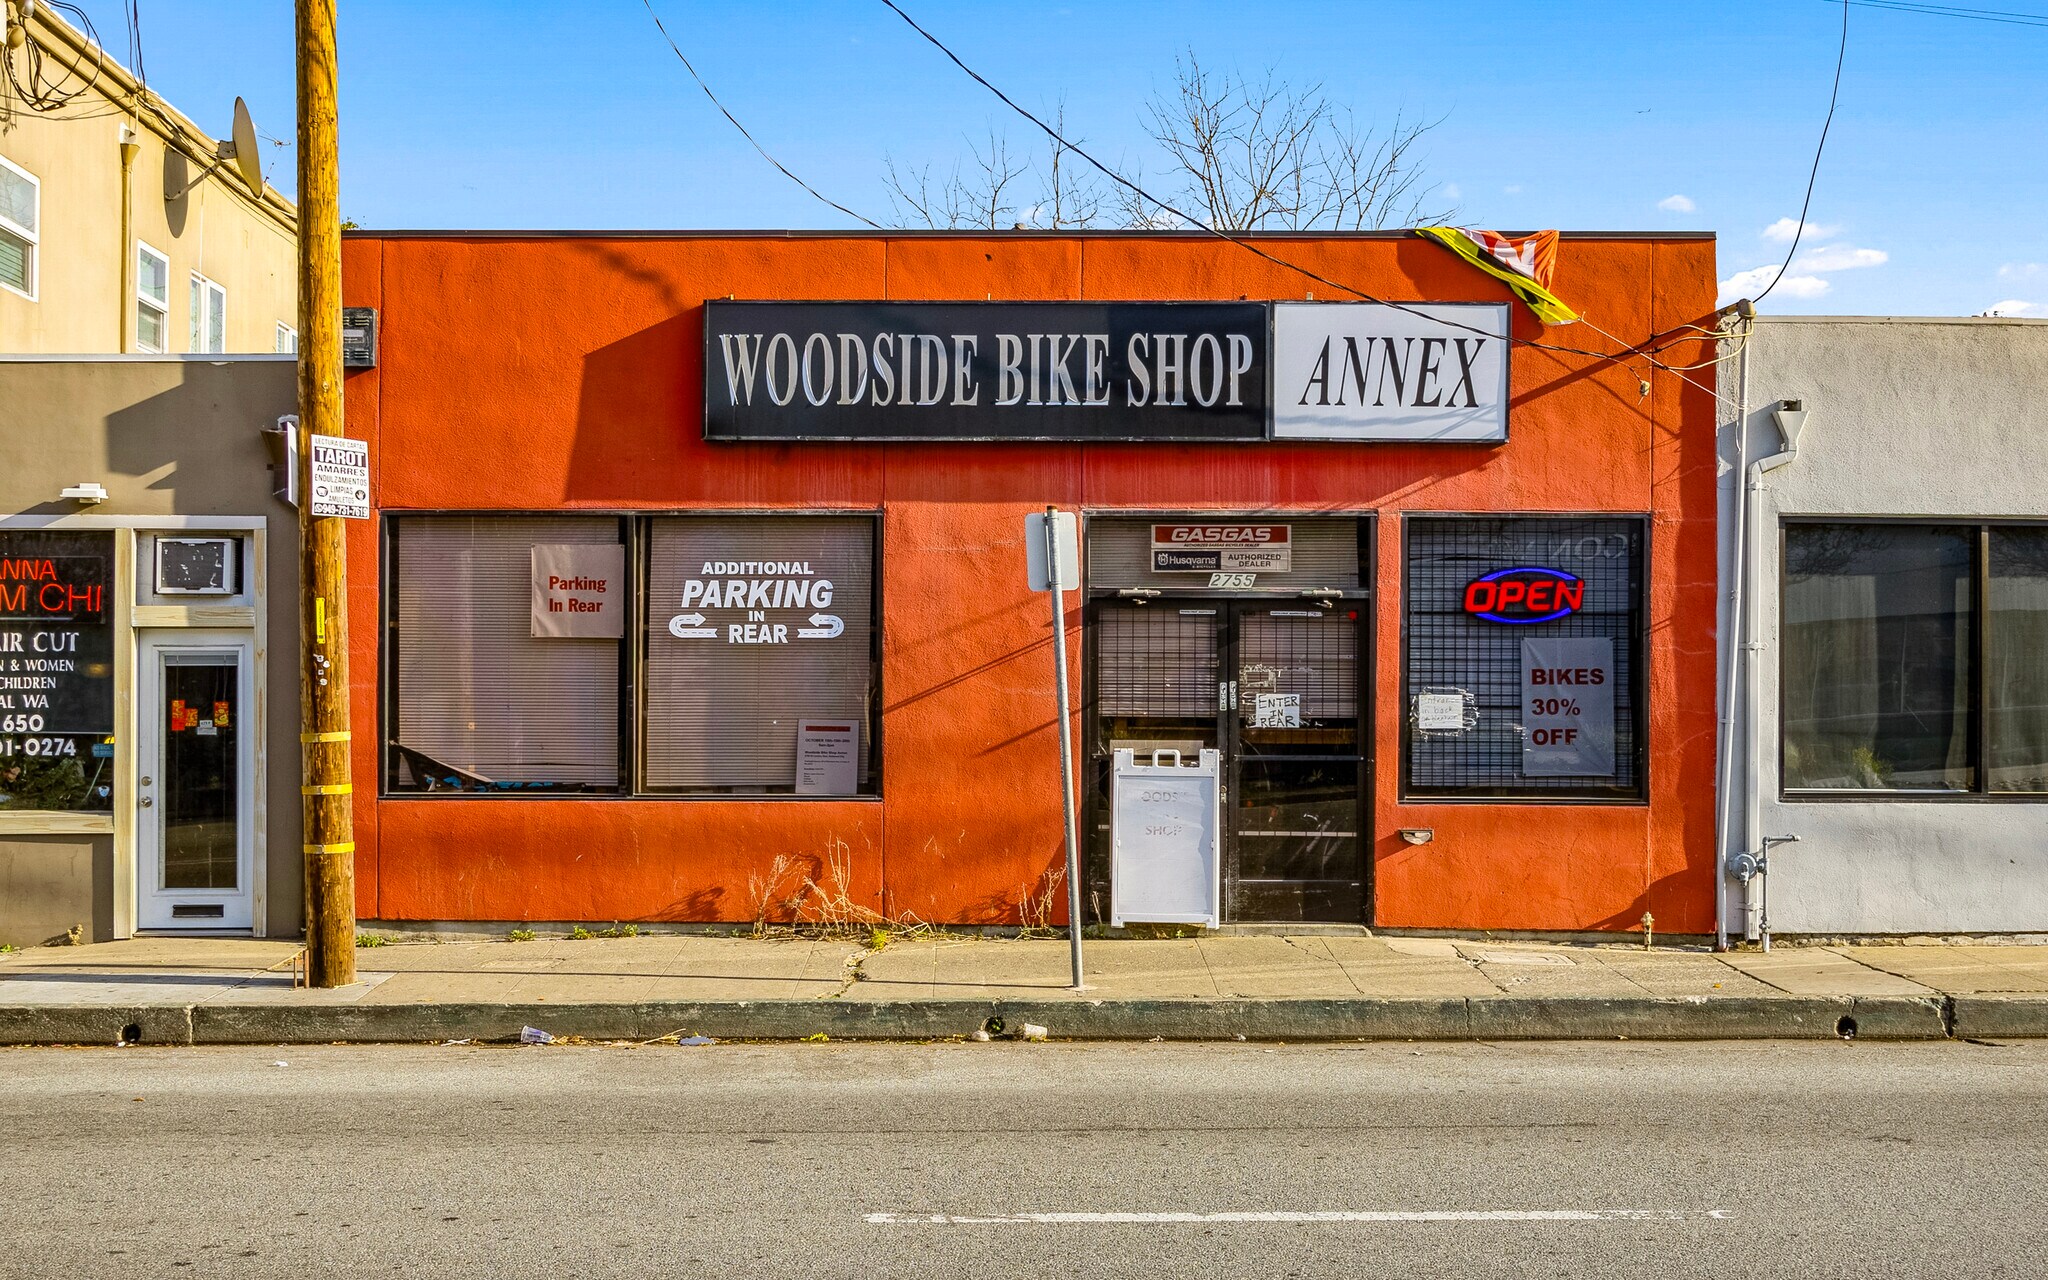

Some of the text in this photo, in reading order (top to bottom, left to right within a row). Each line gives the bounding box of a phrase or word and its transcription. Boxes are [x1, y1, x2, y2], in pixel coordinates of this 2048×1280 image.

[718, 332, 1254, 408] WOODSIDE BIKE SHOP
[1297, 336, 1487, 410] ANNEX
[315, 447, 365, 467] TAROT
[317, 464, 366, 477] AMARRES
[314, 473, 367, 487] ENDULZAMIENTOS
[330, 485, 353, 495] LIMPIAS
[328, 495, 355, 504] AMULETOS
[1171, 527, 1272, 542] GASGAS
[1169, 555, 1216, 566] Husqvarna
[1228, 553, 1282, 561] AUTHORIZED
[1239, 560, 1271, 568] DEALER
[0, 559, 57, 581] NNA
[701, 561, 815, 575] ADDITIONAL
[549, 575, 607, 593] Parking
[1210, 574, 1254, 587] 2755
[39, 583, 103, 612] CHI
[680, 579, 834, 609] PARKING
[1464, 579, 1585, 613] OPEN
[549, 598, 603, 612] In Rear
[748, 610, 765, 622] IN
[0, 631, 80, 652] IR CUT
[728, 624, 789, 644] REAR
[10, 659, 20, 671] &
[24, 659, 74, 672] WOMEN
[1531, 668, 1605, 685] BIKES
[22, 694, 49, 709] WA
[1258, 693, 1299, 709] ENTER
[1531, 698, 1581, 716] 30%
[1260, 715, 1296, 727] REAR
[1270, 709, 1284, 718] IN
[3, 714, 45, 732] 650
[1531, 728, 1578, 746] OFF
